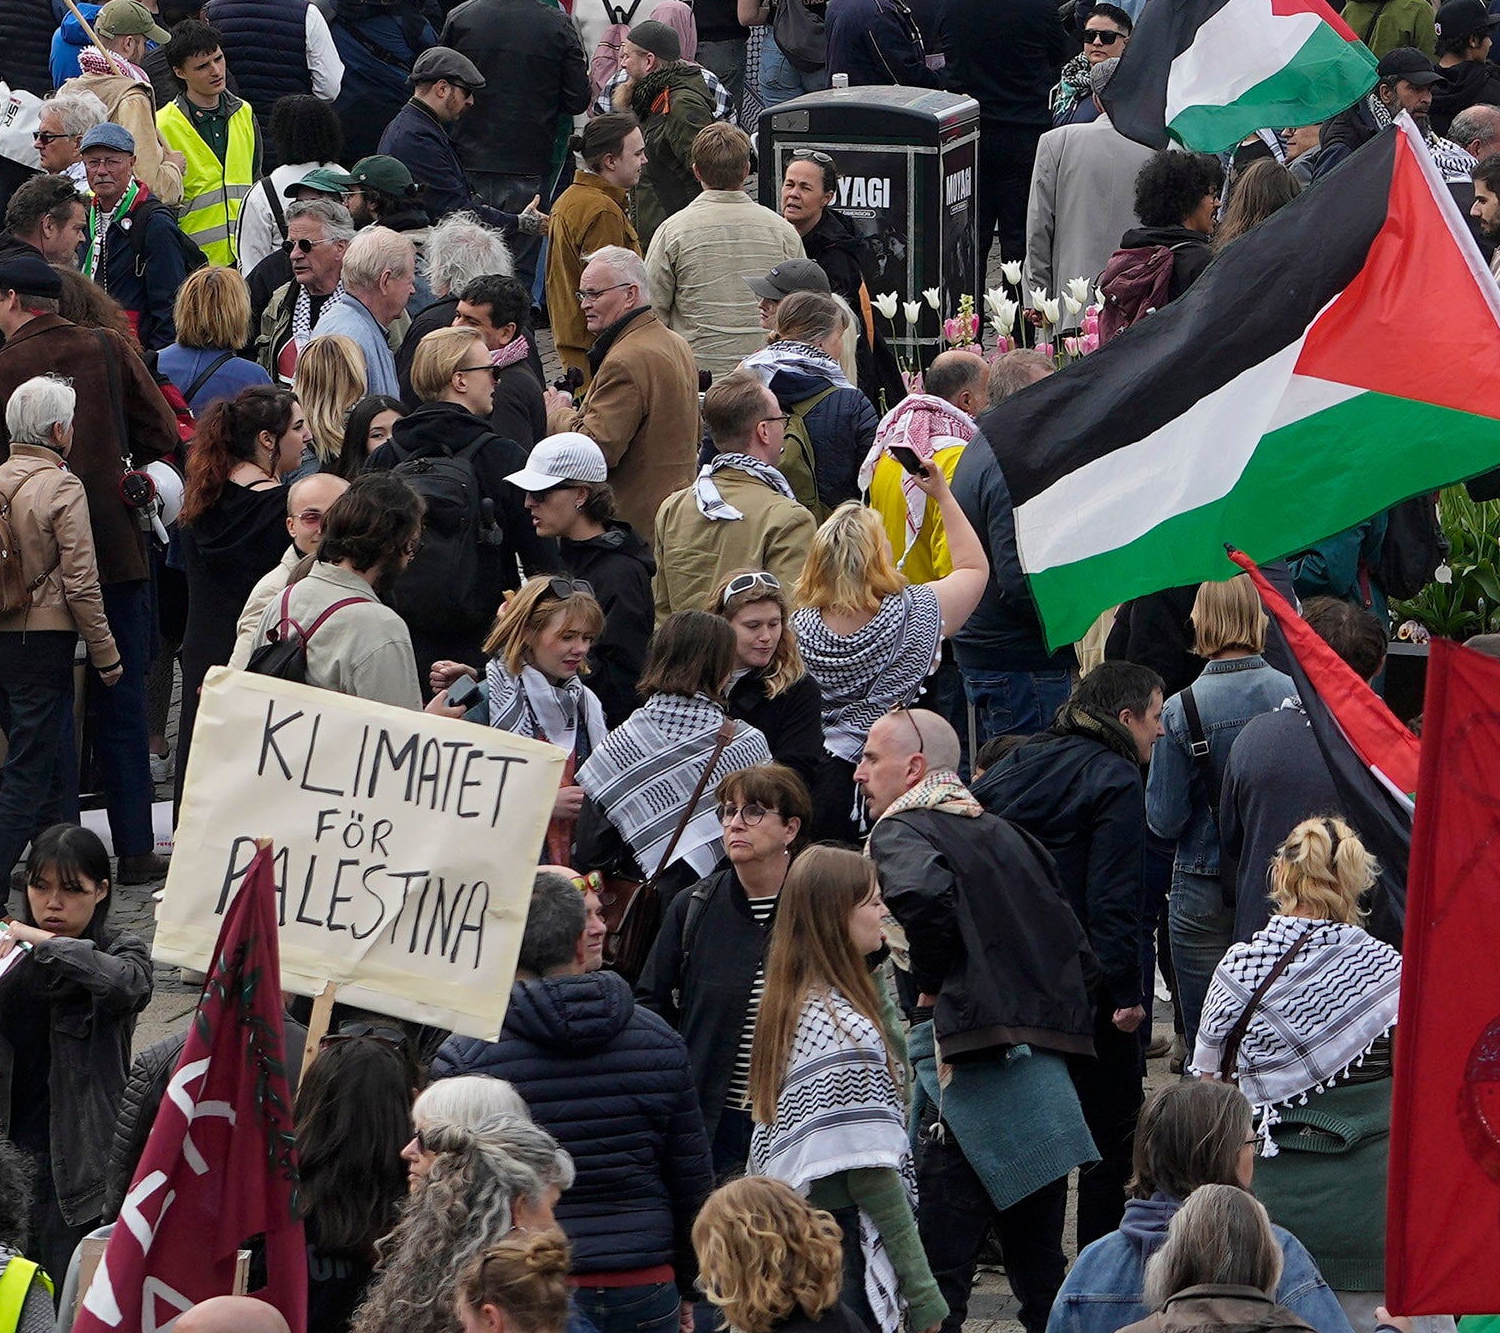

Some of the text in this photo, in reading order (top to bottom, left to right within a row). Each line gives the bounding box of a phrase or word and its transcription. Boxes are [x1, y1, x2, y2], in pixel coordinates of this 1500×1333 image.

[828, 176, 891, 209] YAGI
[946, 166, 972, 206] MOYAGI
[257, 698, 529, 828] KLIMATET
[314, 808, 393, 858] FÖR
